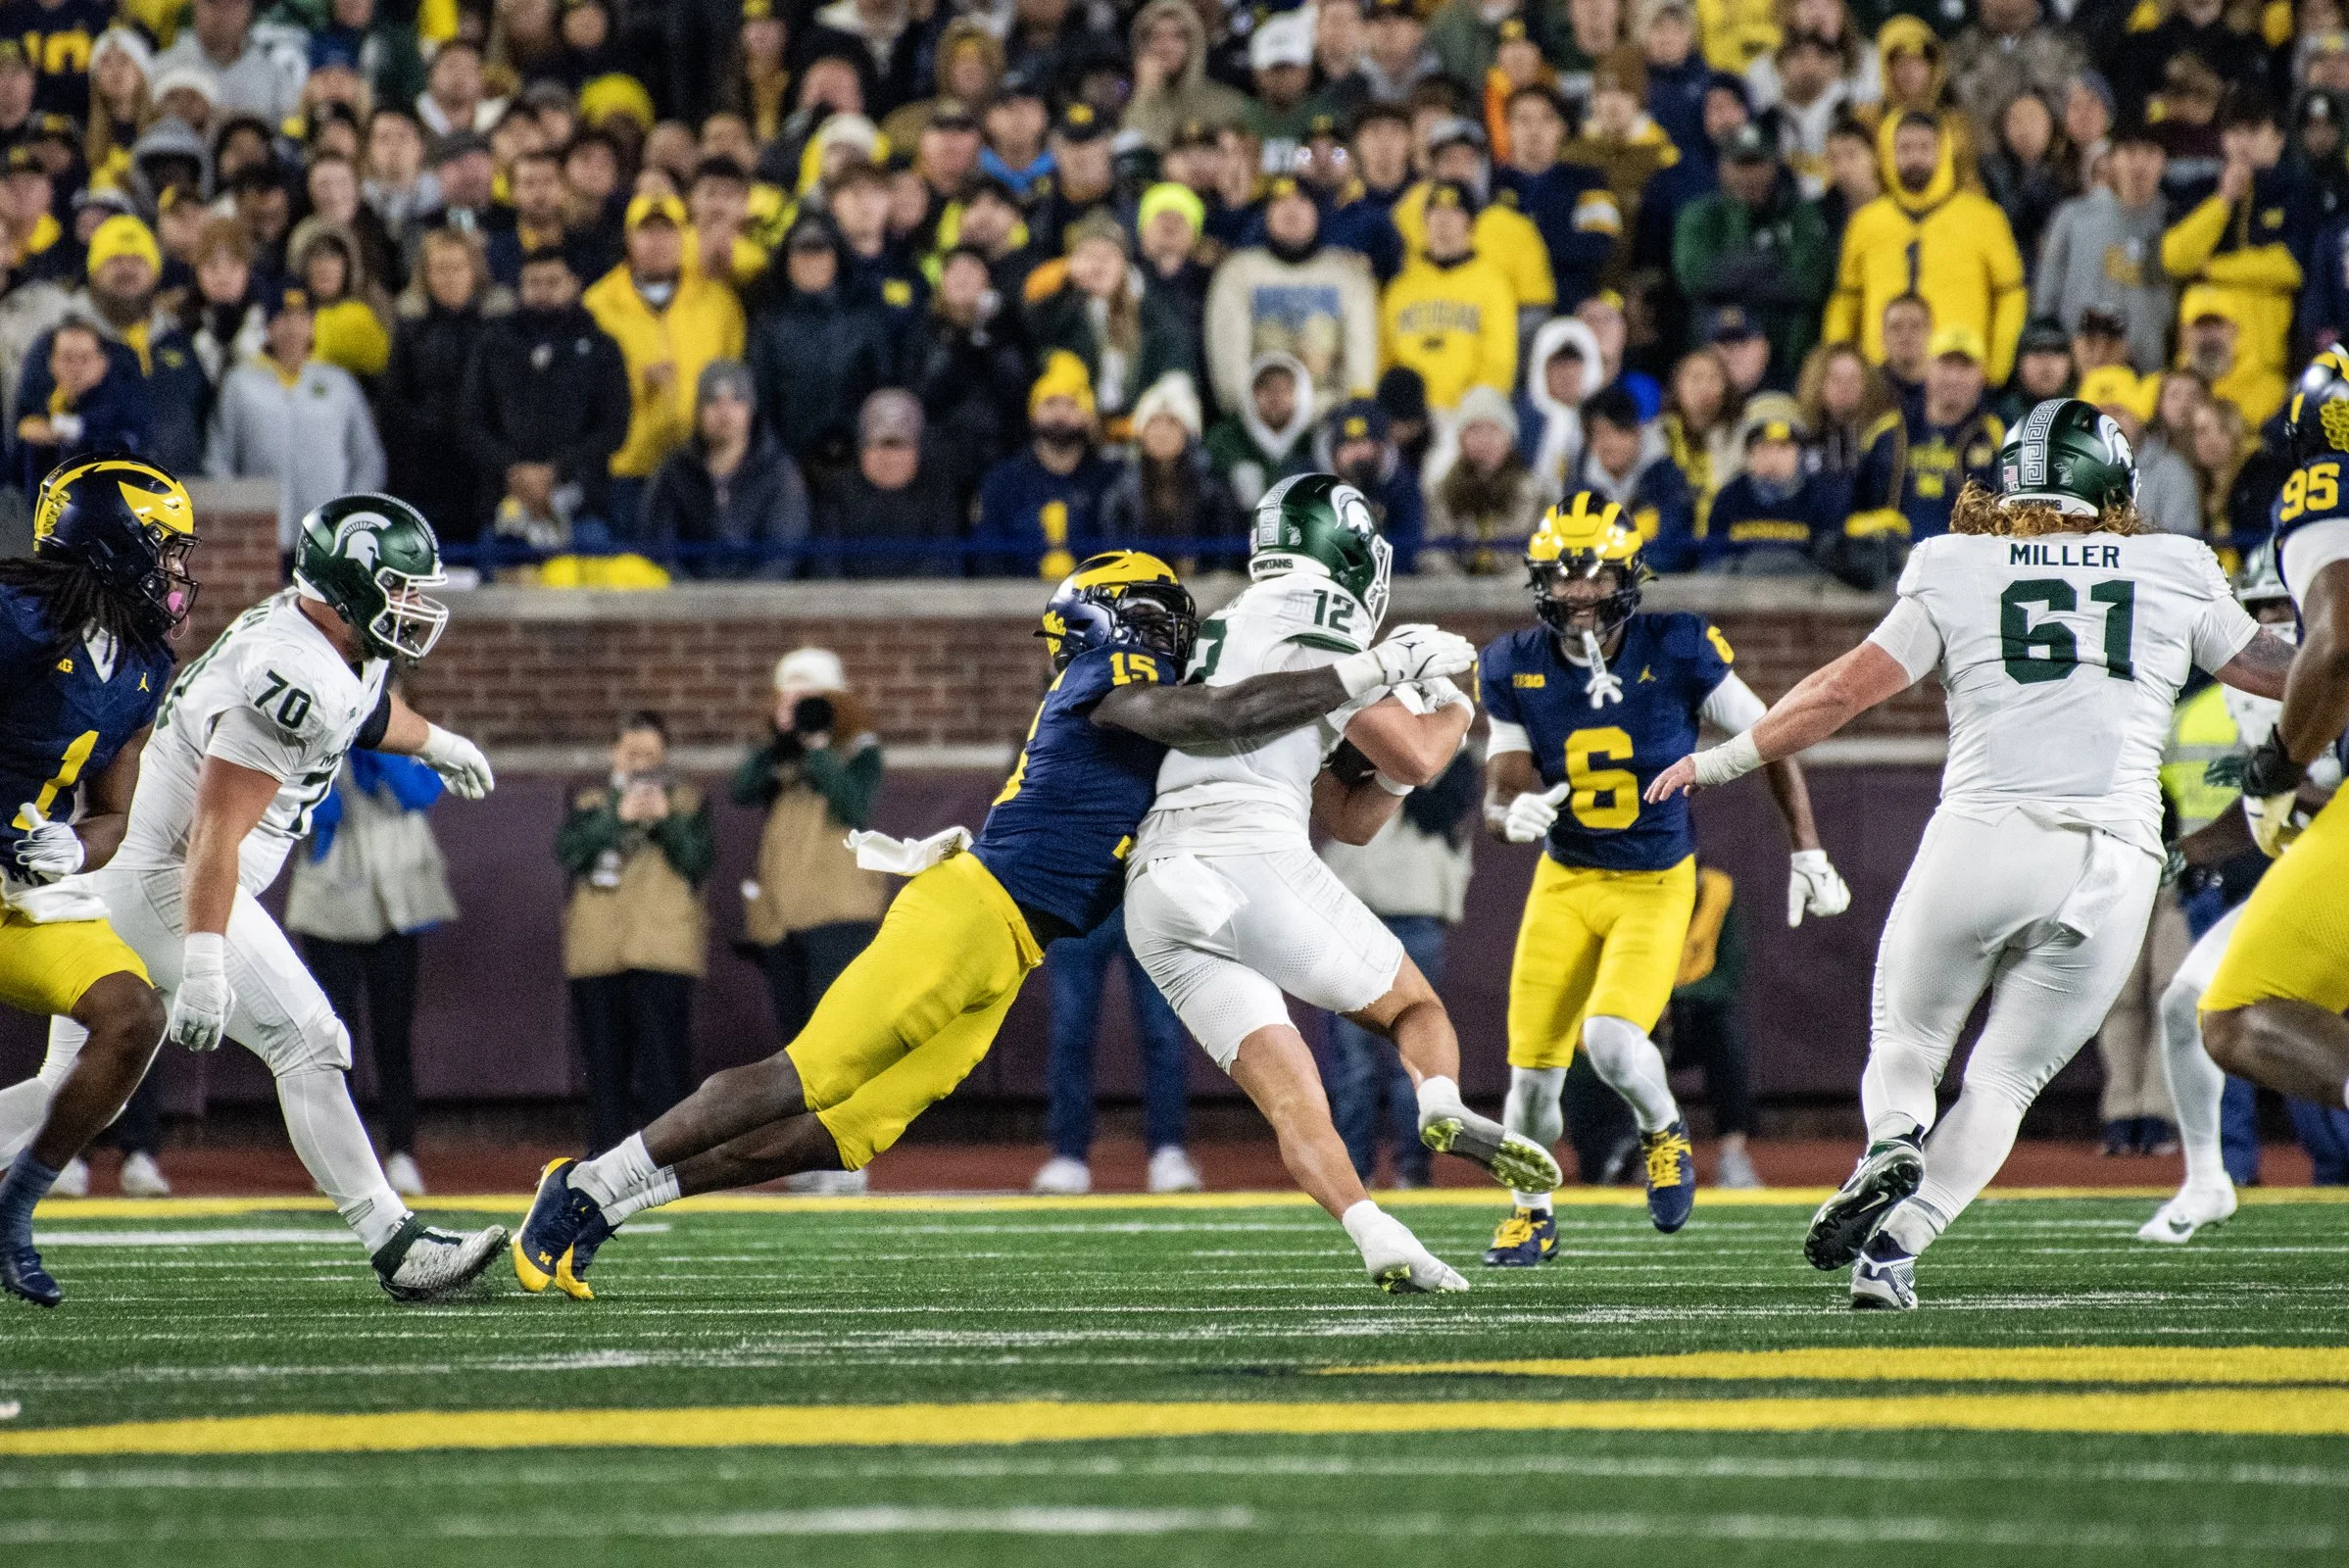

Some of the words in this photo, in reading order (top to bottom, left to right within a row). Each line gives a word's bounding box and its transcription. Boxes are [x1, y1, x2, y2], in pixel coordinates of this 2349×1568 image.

[2279, 463, 2340, 521] 95
[1252, 559, 1294, 573] SPARTANS
[2010, 543, 2120, 568] MILLER
[1313, 589, 1356, 635] 12
[2000, 578, 2135, 685] 61
[1109, 652, 1158, 685] 15
[254, 668, 312, 729] 70
[12, 729, 99, 831] 1
[1564, 725, 1639, 829] 6
